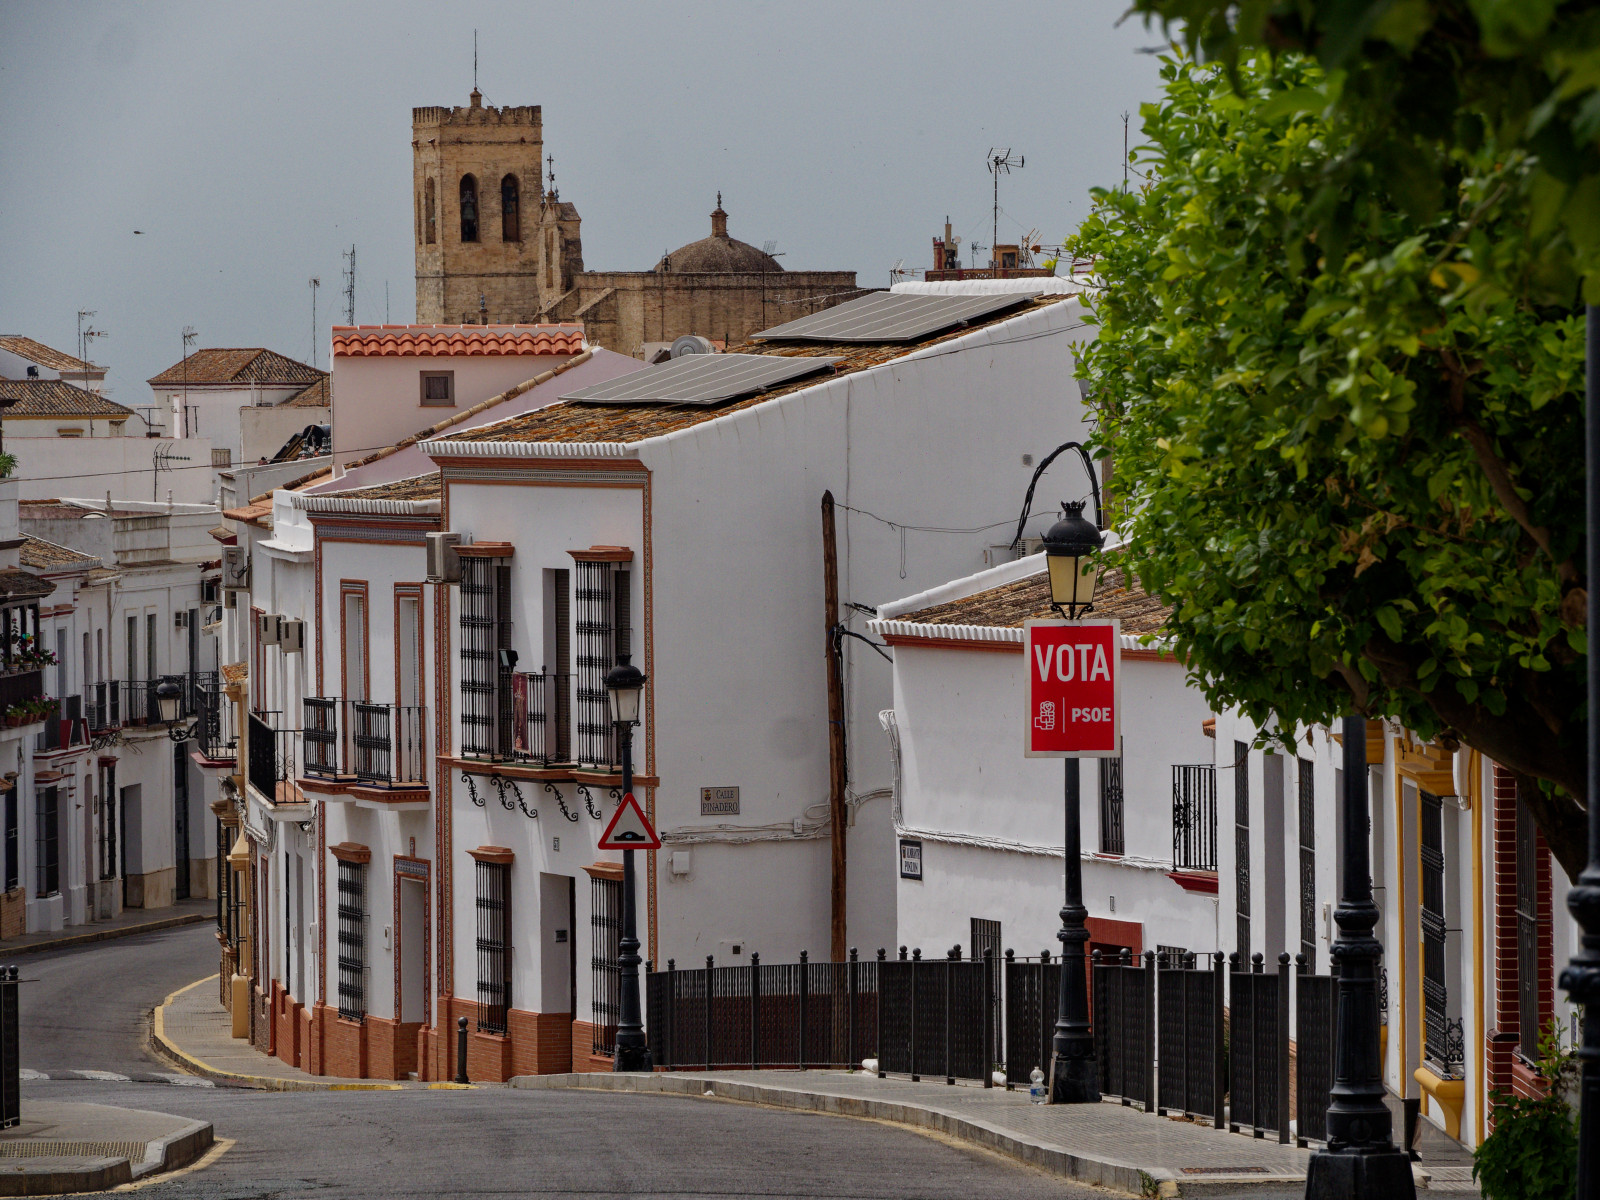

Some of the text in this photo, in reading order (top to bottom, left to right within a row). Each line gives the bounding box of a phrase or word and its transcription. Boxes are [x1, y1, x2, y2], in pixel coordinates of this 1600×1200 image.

[1034, 643, 1111, 682] VOTA
[1071, 707, 1112, 723] PSOE
[716, 789, 735, 800] CALLE
[702, 801, 738, 813] PINADERO
